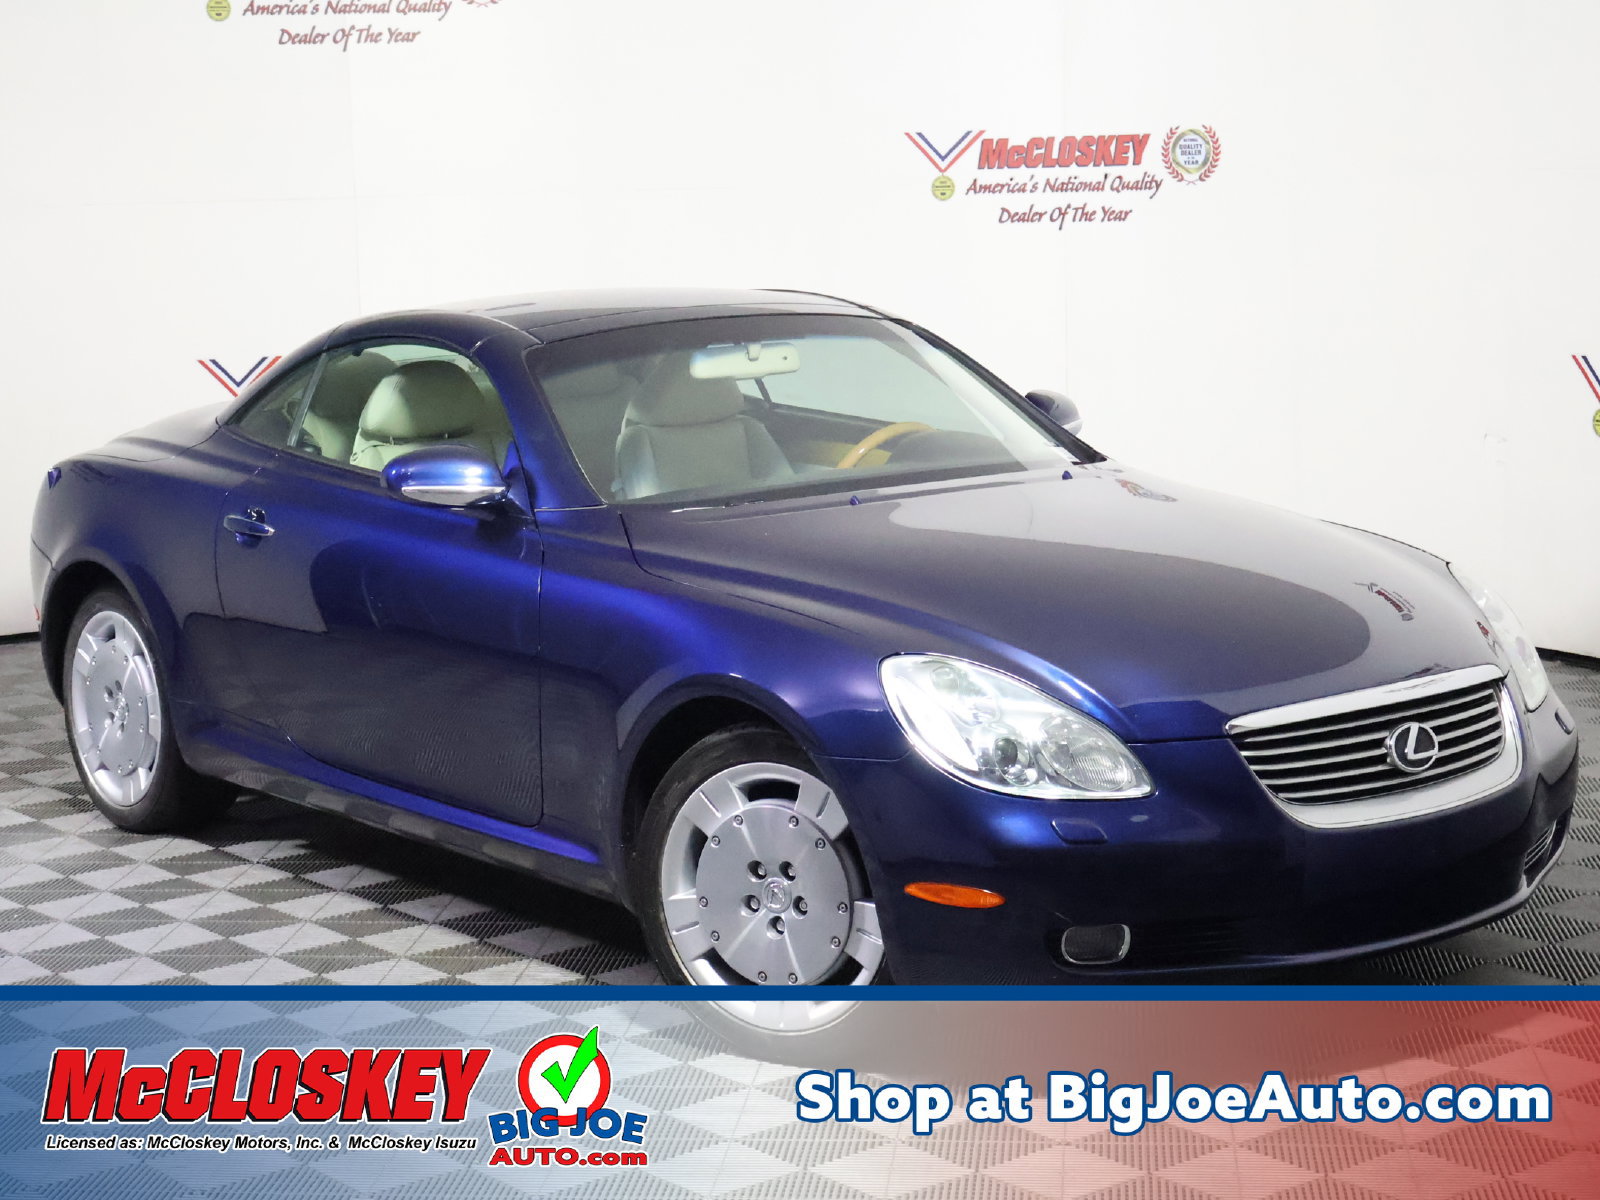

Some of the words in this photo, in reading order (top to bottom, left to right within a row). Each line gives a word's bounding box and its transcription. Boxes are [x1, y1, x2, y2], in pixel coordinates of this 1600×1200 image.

[278, 26, 330, 45] Dealer
[332, 26, 355, 52] Of
[355, 25, 383, 44] The
[386, 28, 421, 44] Year
[977, 133, 1151, 169] McCLOSKEY
[965, 175, 1039, 196] America's
[1042, 174, 1108, 194] National
[1110, 172, 1163, 199] Quality
[999, 204, 1047, 223] Dealer
[1049, 203, 1072, 231] Of
[1072, 203, 1097, 222] The
[1101, 206, 1133, 222] Year
